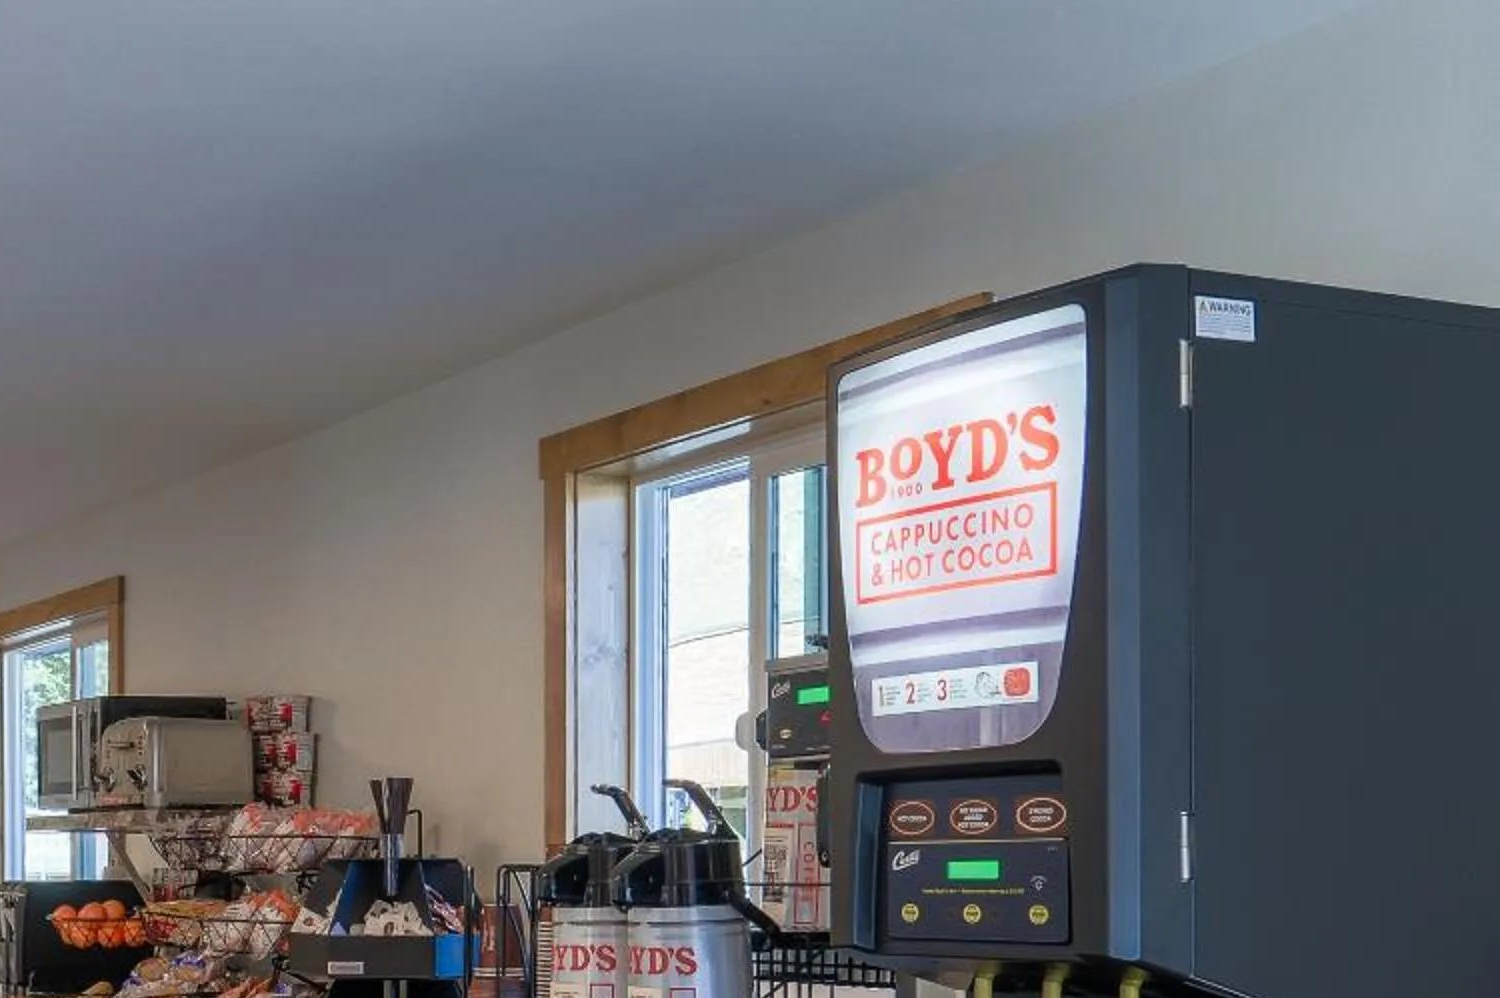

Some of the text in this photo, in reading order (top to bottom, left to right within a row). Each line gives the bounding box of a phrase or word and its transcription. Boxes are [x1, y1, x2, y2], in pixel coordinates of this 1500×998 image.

[855, 404, 1060, 508] BOYD'S
[871, 503, 1034, 556] CAPPUCCINO
[871, 536, 1034, 587] & HOT COCOA
[905, 681, 916, 704] 2
[937, 679, 947, 701] 3
[551, 944, 617, 971] YD'S
[629, 945, 697, 975] YD'S
